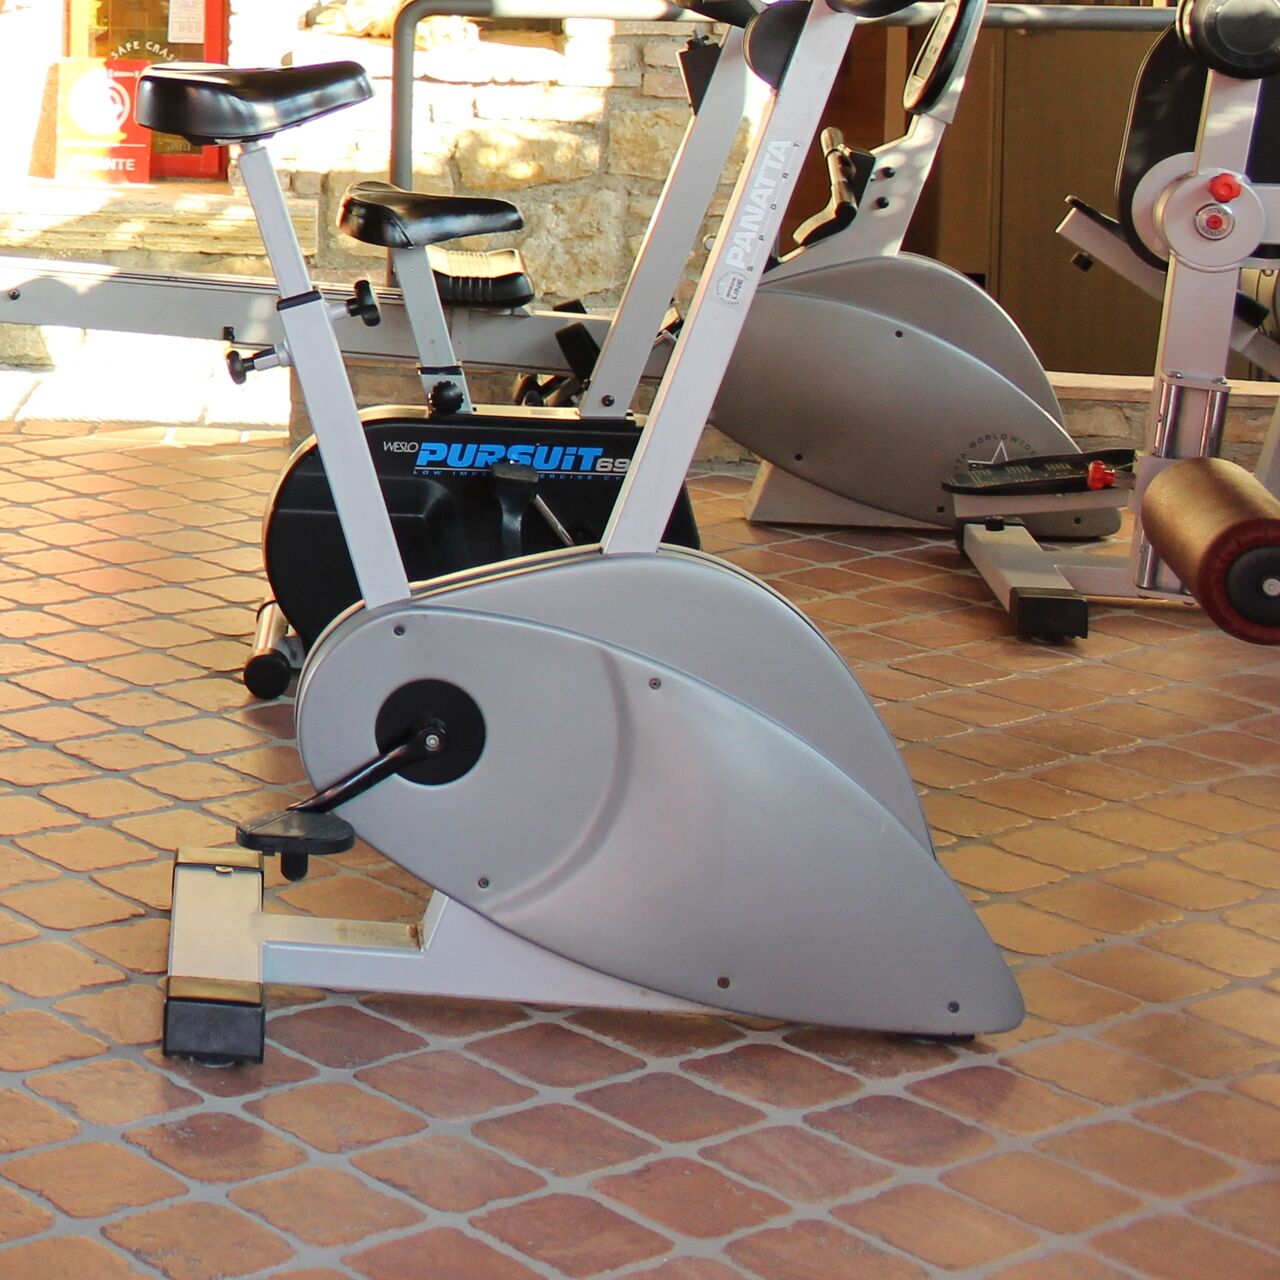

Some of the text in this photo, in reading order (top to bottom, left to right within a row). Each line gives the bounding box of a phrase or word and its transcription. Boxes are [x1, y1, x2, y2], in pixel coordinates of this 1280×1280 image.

[111, 41, 178, 61] SAFE CRAS
[725, 141, 791, 268] PANATTA
[383, 441, 419, 453] WESLO
